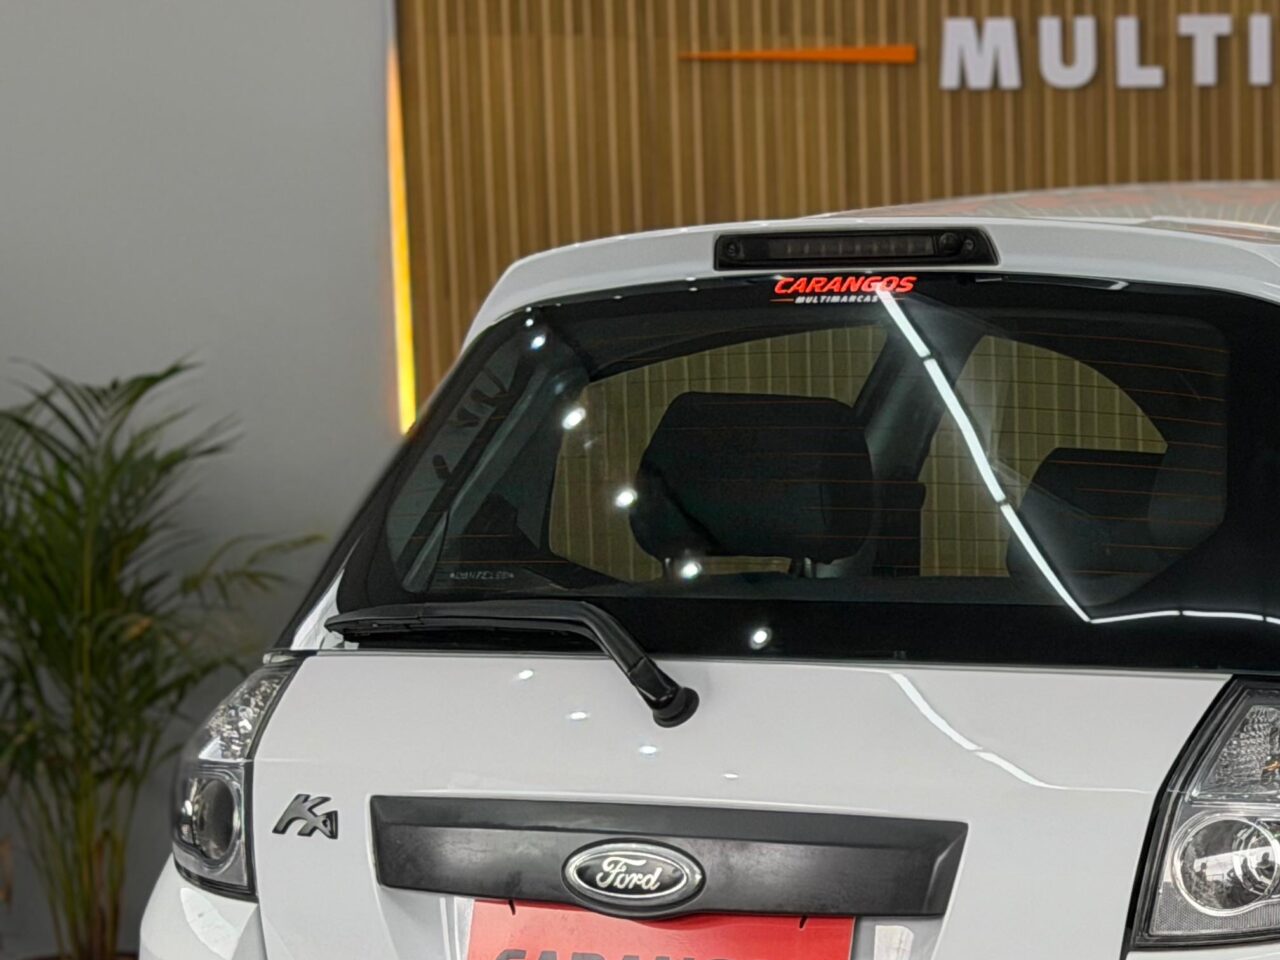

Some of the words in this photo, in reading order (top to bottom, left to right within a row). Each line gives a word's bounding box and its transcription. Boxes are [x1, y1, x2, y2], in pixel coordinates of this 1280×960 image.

[774, 276, 917, 294] CARANGOS
[795, 295, 880, 304] MULTIMARCAS
[596, 856, 663, 890] Ford
